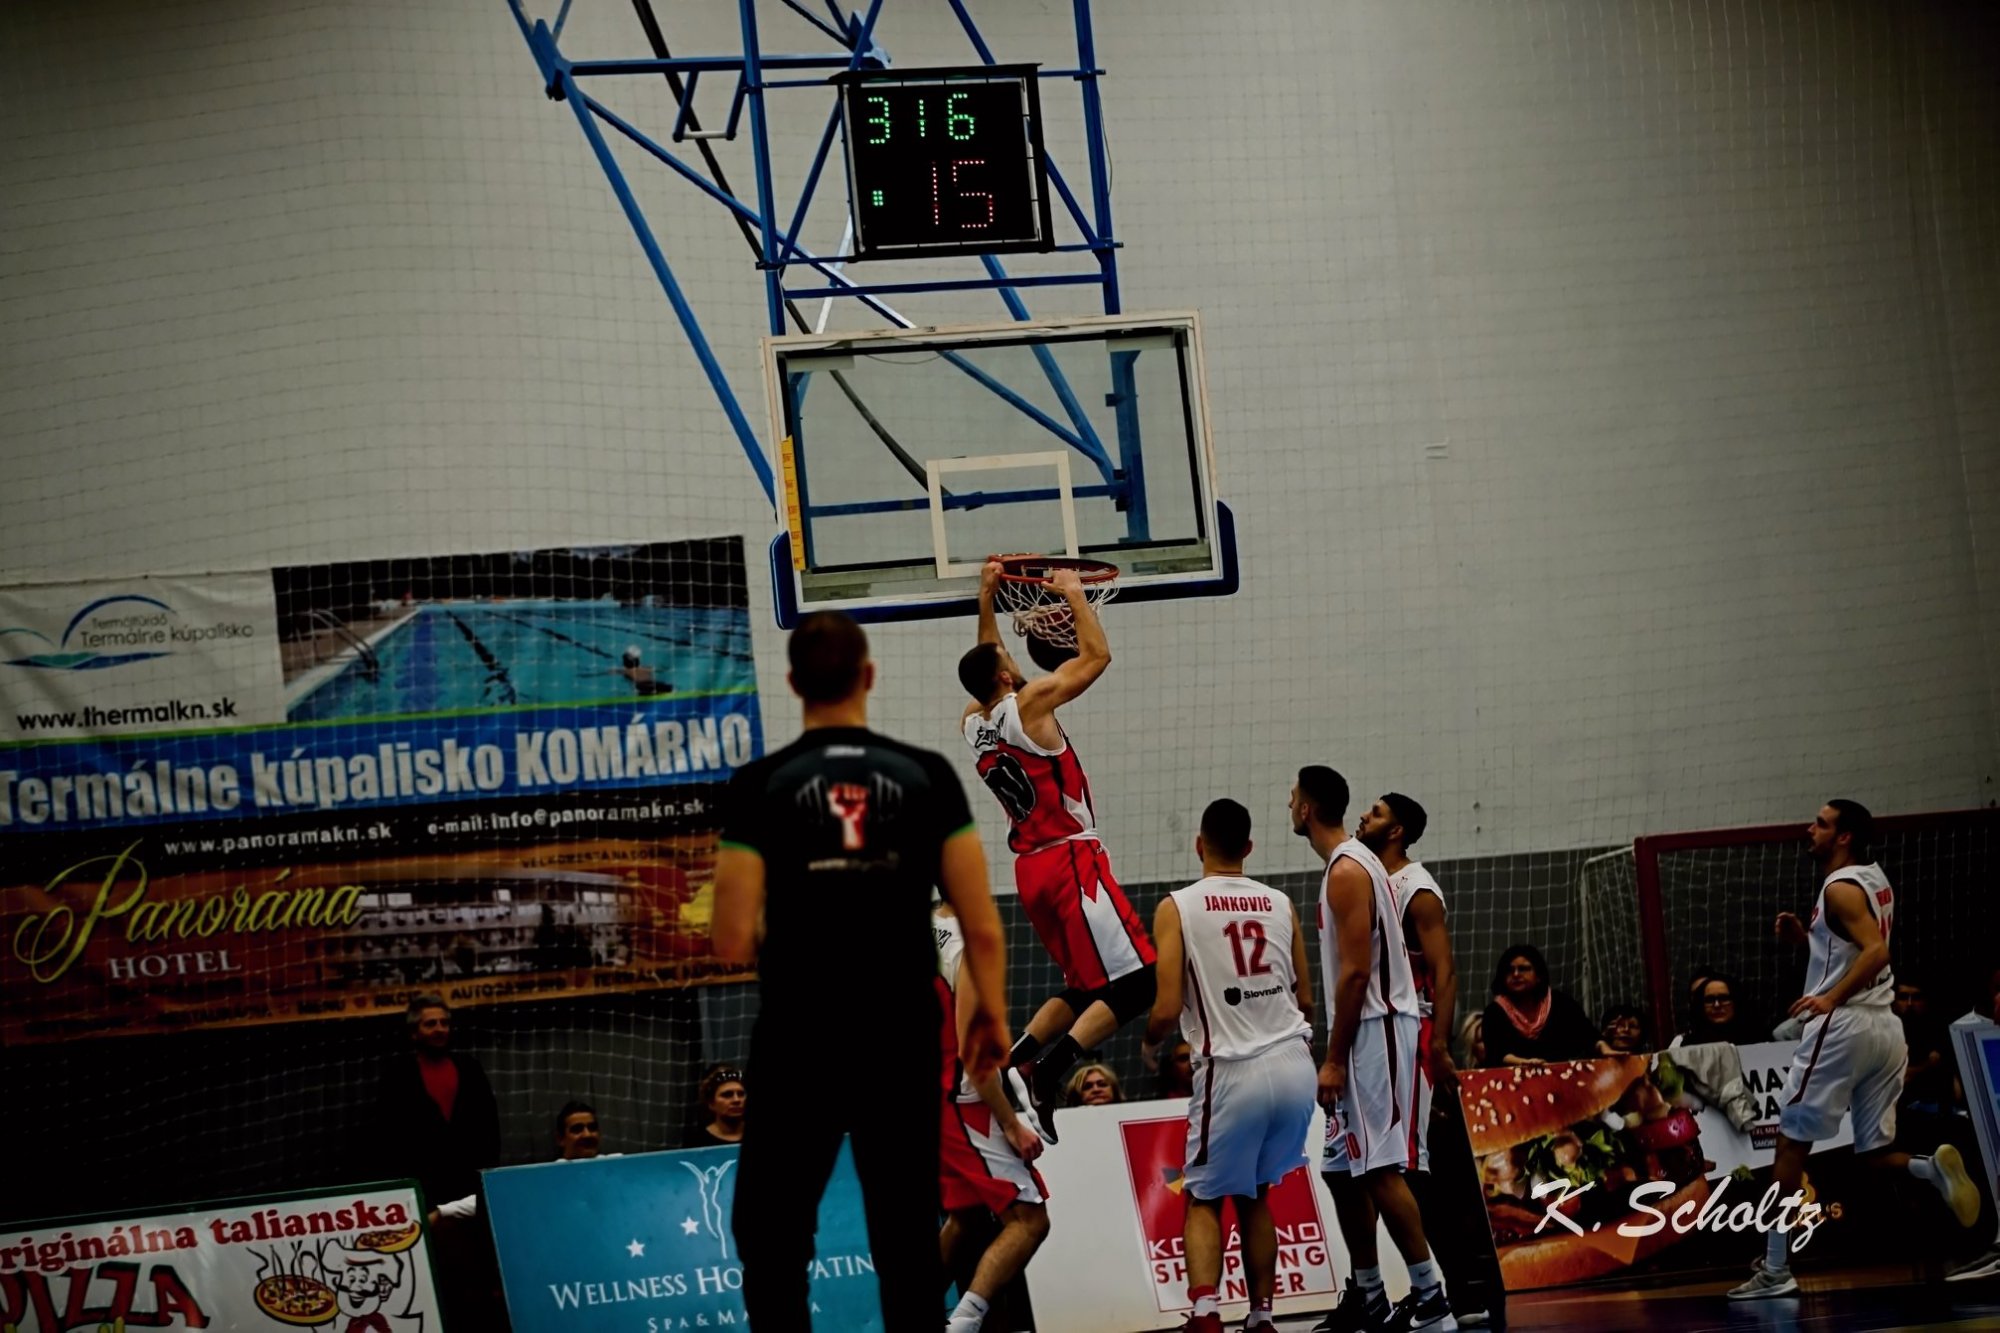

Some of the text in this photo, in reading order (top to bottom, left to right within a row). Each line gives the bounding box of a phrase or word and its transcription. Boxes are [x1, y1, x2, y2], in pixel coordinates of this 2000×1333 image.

[931, 159, 994, 229] 15
[80, 627, 167, 648] Termálne
[17, 697, 238, 731] www.thermalkn.sk
[0, 712, 752, 826] Termálne kúpalisko KOMÁRNO
[164, 821, 393, 856] www.panoramakn.sk
[13, 837, 367, 984] Panoráma
[108, 950, 242, 980] HOTEL
[1223, 920, 1271, 977] 12
[209, 1200, 408, 1245] talianska
[1149, 1222, 1322, 1259] KOÁNO
[548, 1273, 688, 1311] WELLNESS
